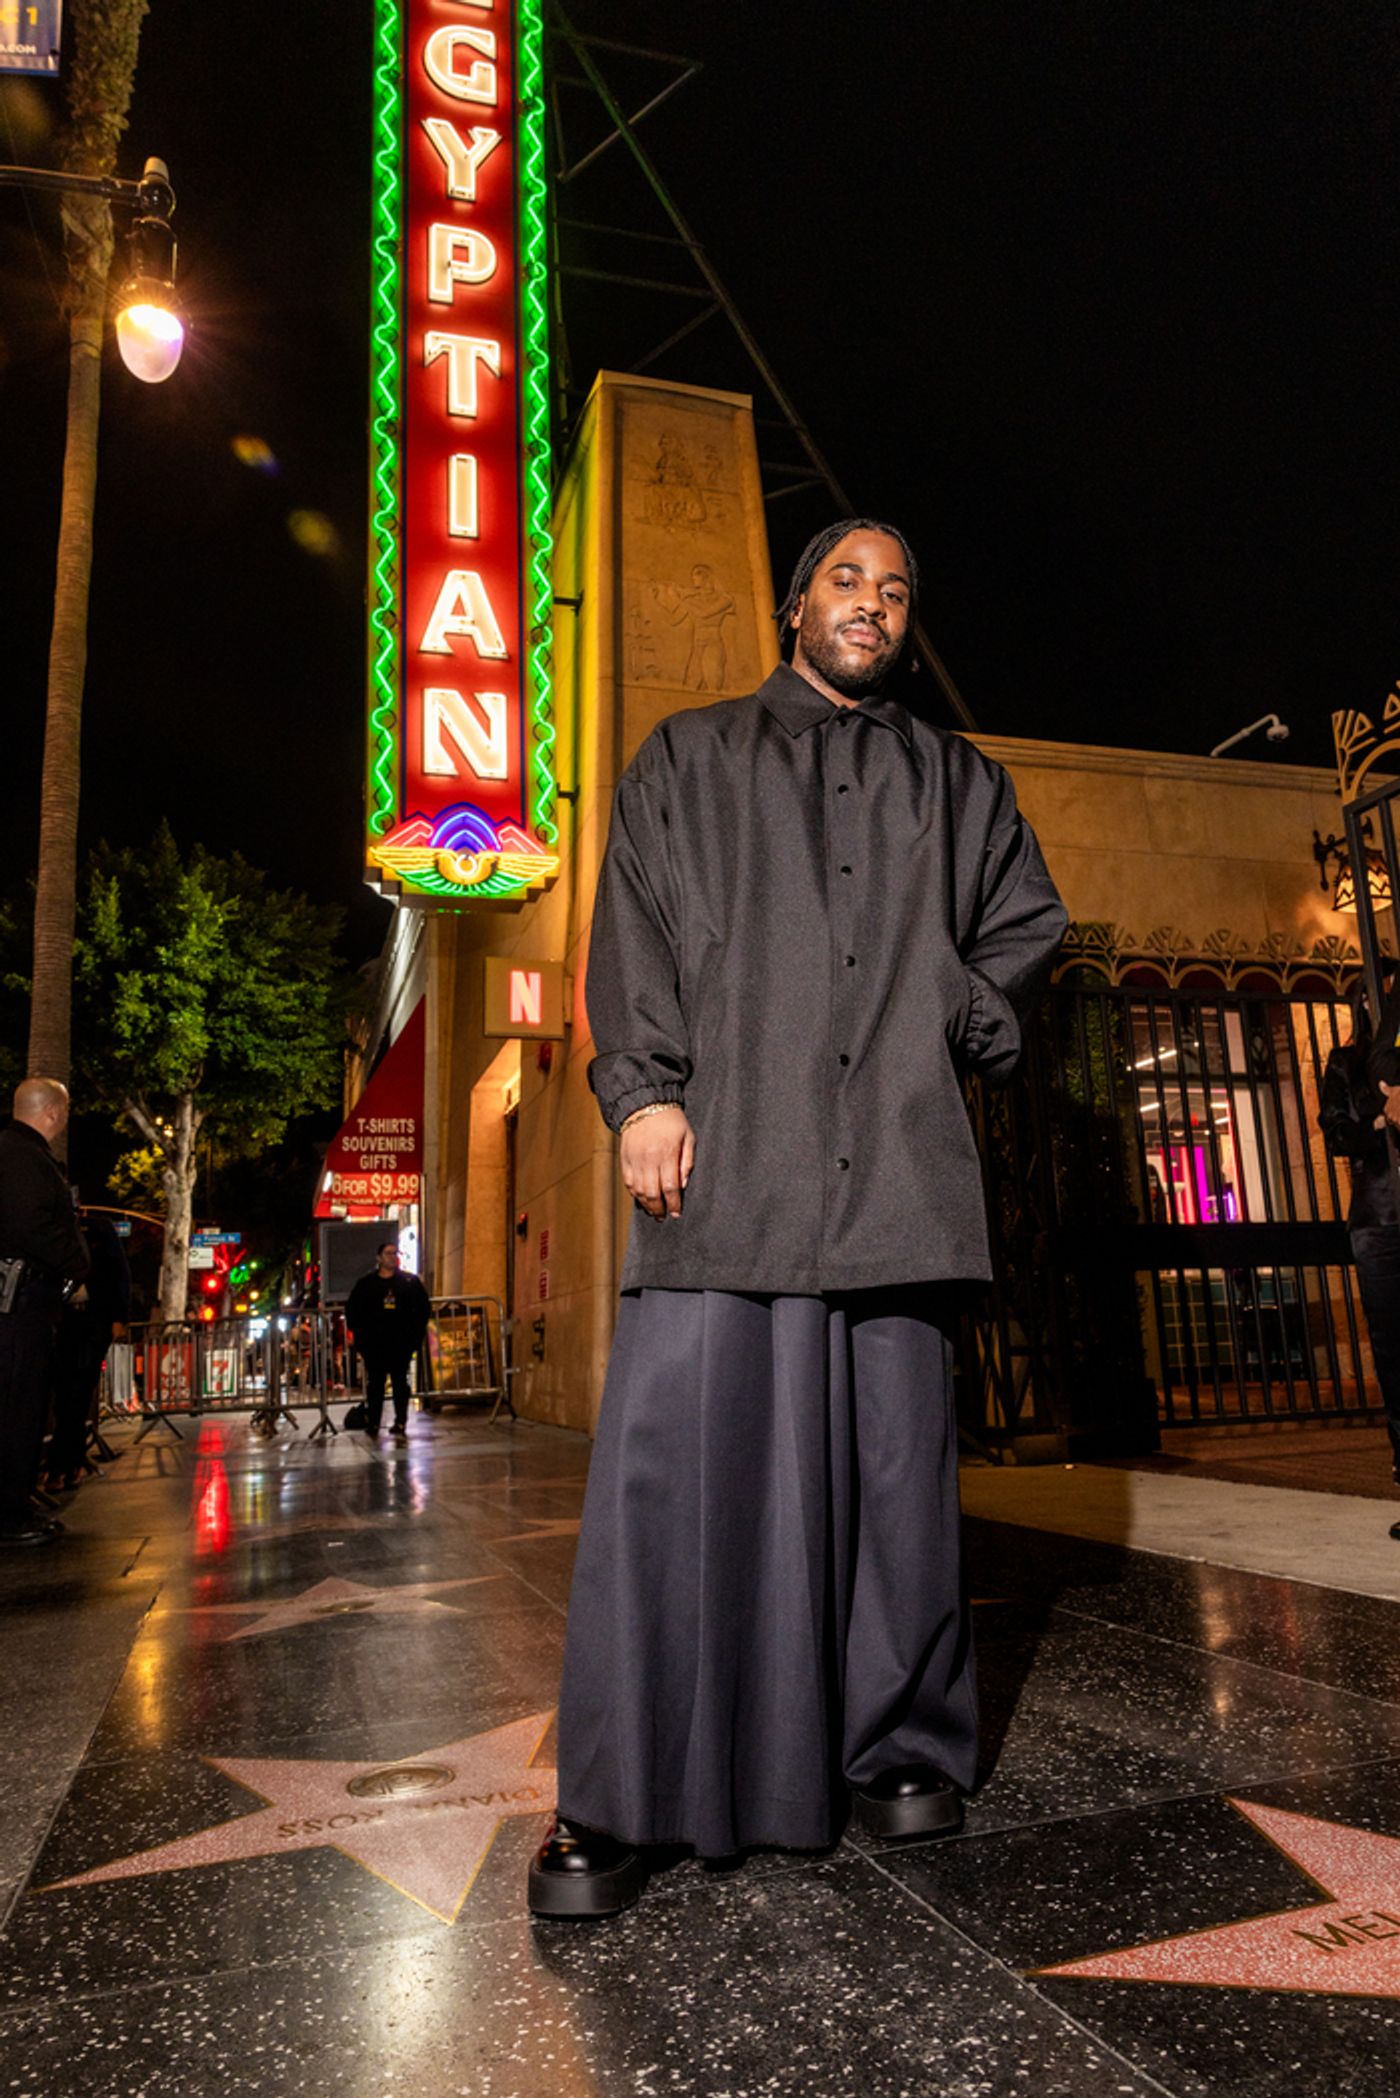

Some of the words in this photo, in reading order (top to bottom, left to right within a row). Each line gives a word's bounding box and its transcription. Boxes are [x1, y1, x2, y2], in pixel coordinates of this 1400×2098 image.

[419, 0, 509, 779] GYPTIAN
[510, 971, 541, 1023] N
[357, 1118, 415, 1134] T-SHIRTS
[341, 1136, 415, 1152] SOUVENIRS
[360, 1154, 397, 1170] GIFTS
[369, 1172, 419, 1198] $9.99
[277, 1809, 384, 1839] ROSS
